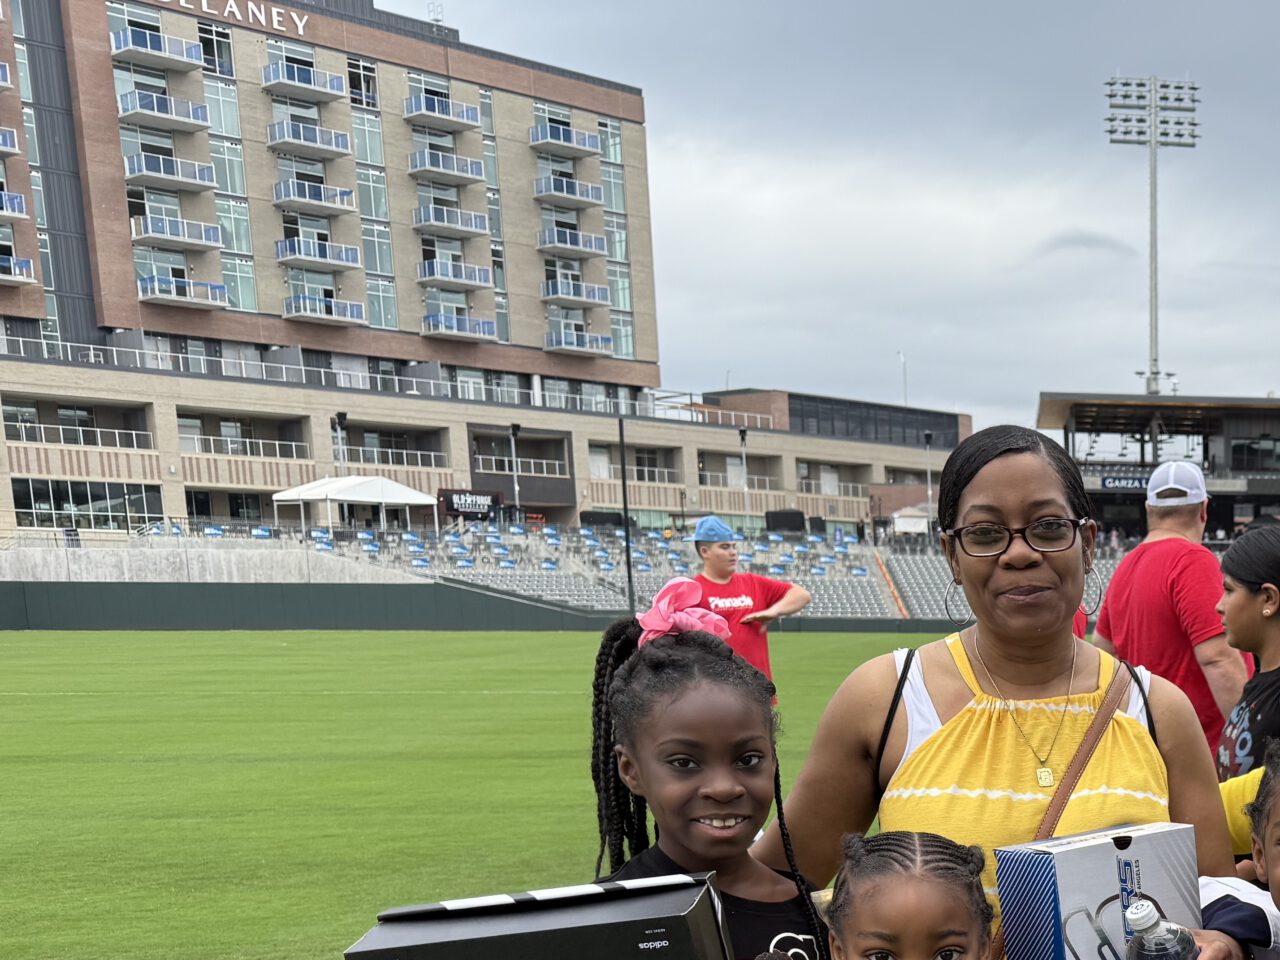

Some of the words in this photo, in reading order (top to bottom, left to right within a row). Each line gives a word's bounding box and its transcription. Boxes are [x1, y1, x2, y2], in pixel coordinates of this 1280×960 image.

[159, 0, 309, 35] LANEY
[1105, 478, 1139, 488] GARZA
[639, 939, 669, 949] adidas
